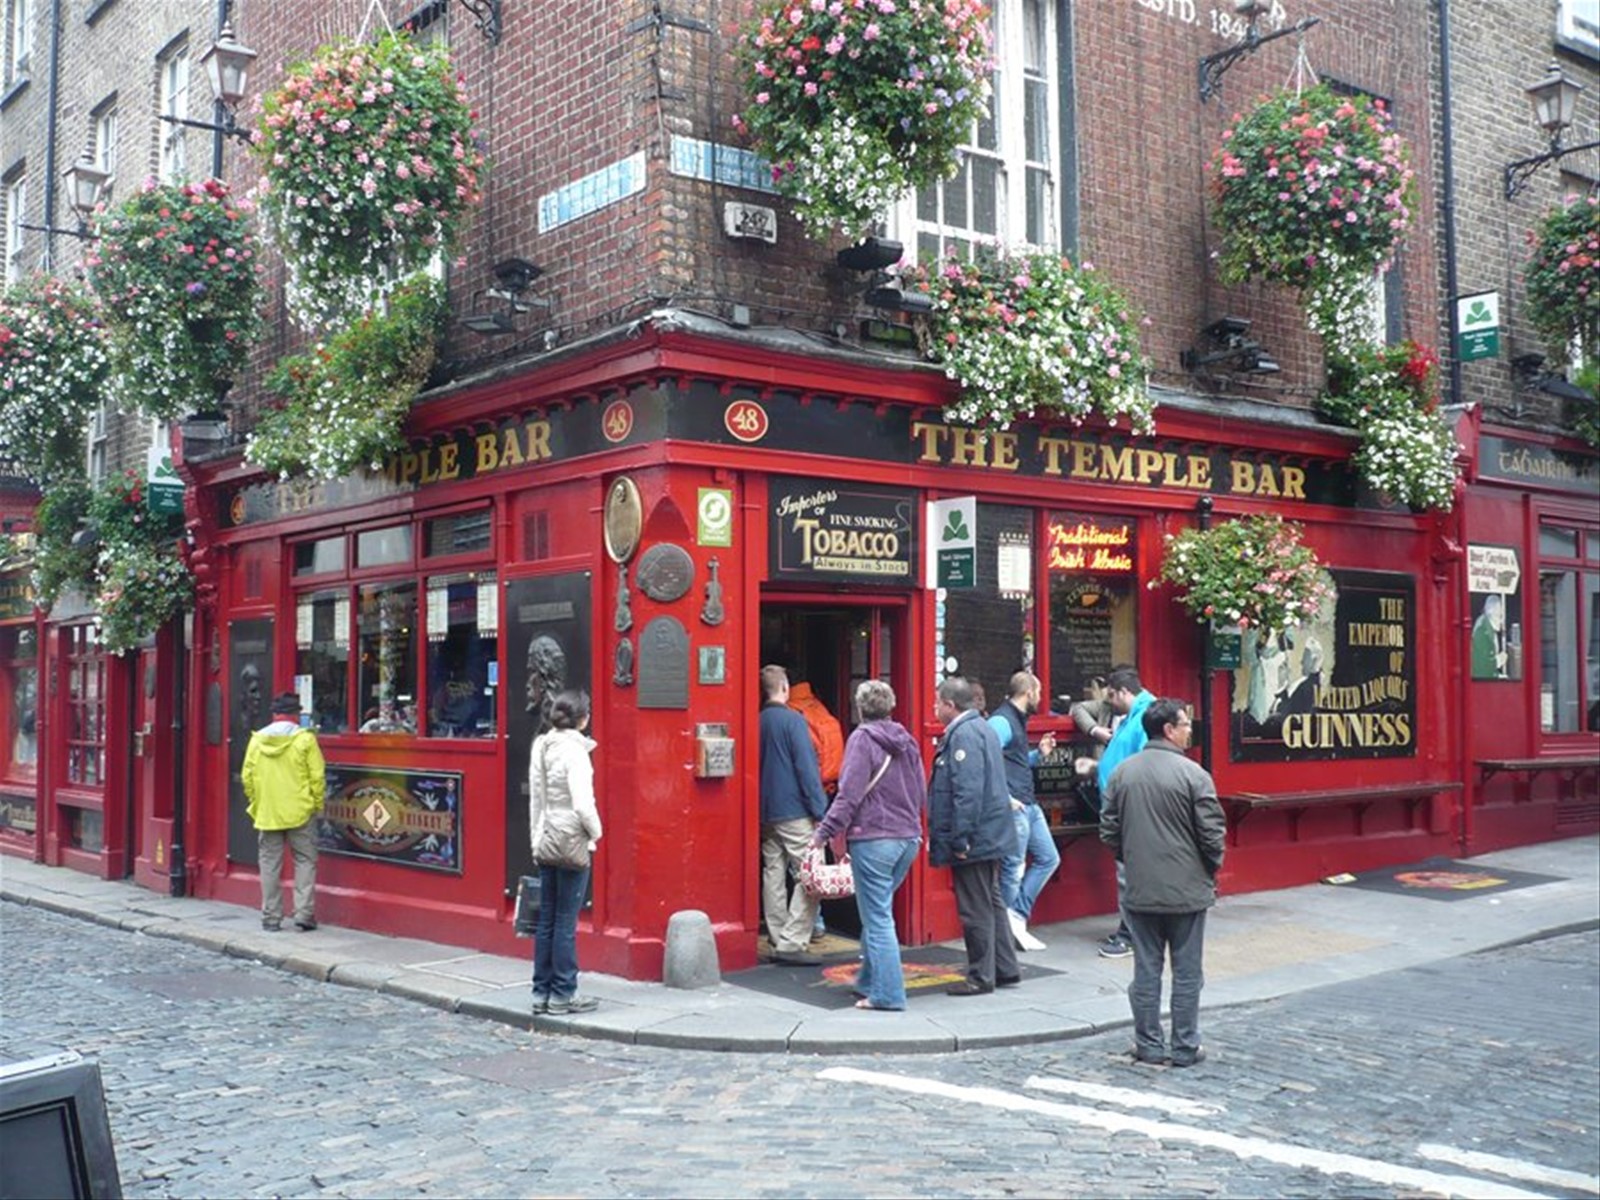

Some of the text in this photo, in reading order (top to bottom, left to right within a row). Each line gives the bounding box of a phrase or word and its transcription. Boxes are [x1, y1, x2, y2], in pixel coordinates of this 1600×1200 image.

[607, 408, 628, 435] 48
[731, 406, 760, 432] 48
[477, 420, 553, 472] BAR
[913, 421, 1307, 499] THE TEMPLE BAR
[776, 490, 838, 517] Importers
[830, 514, 898, 530] FINE SMOKING
[1048, 524, 1128, 545] Traditional
[792, 518, 899, 564] TOBACCO
[815, 557, 907, 573] Always in Stock
[1090, 548, 1132, 570] Music
[1379, 598, 1404, 621] THE
[1349, 622, 1404, 647] EMPEROR
[1389, 651, 1404, 673] OF
[1313, 675, 1409, 710] MALTED LIQUORS
[1281, 712, 1412, 749] GUINNESS
